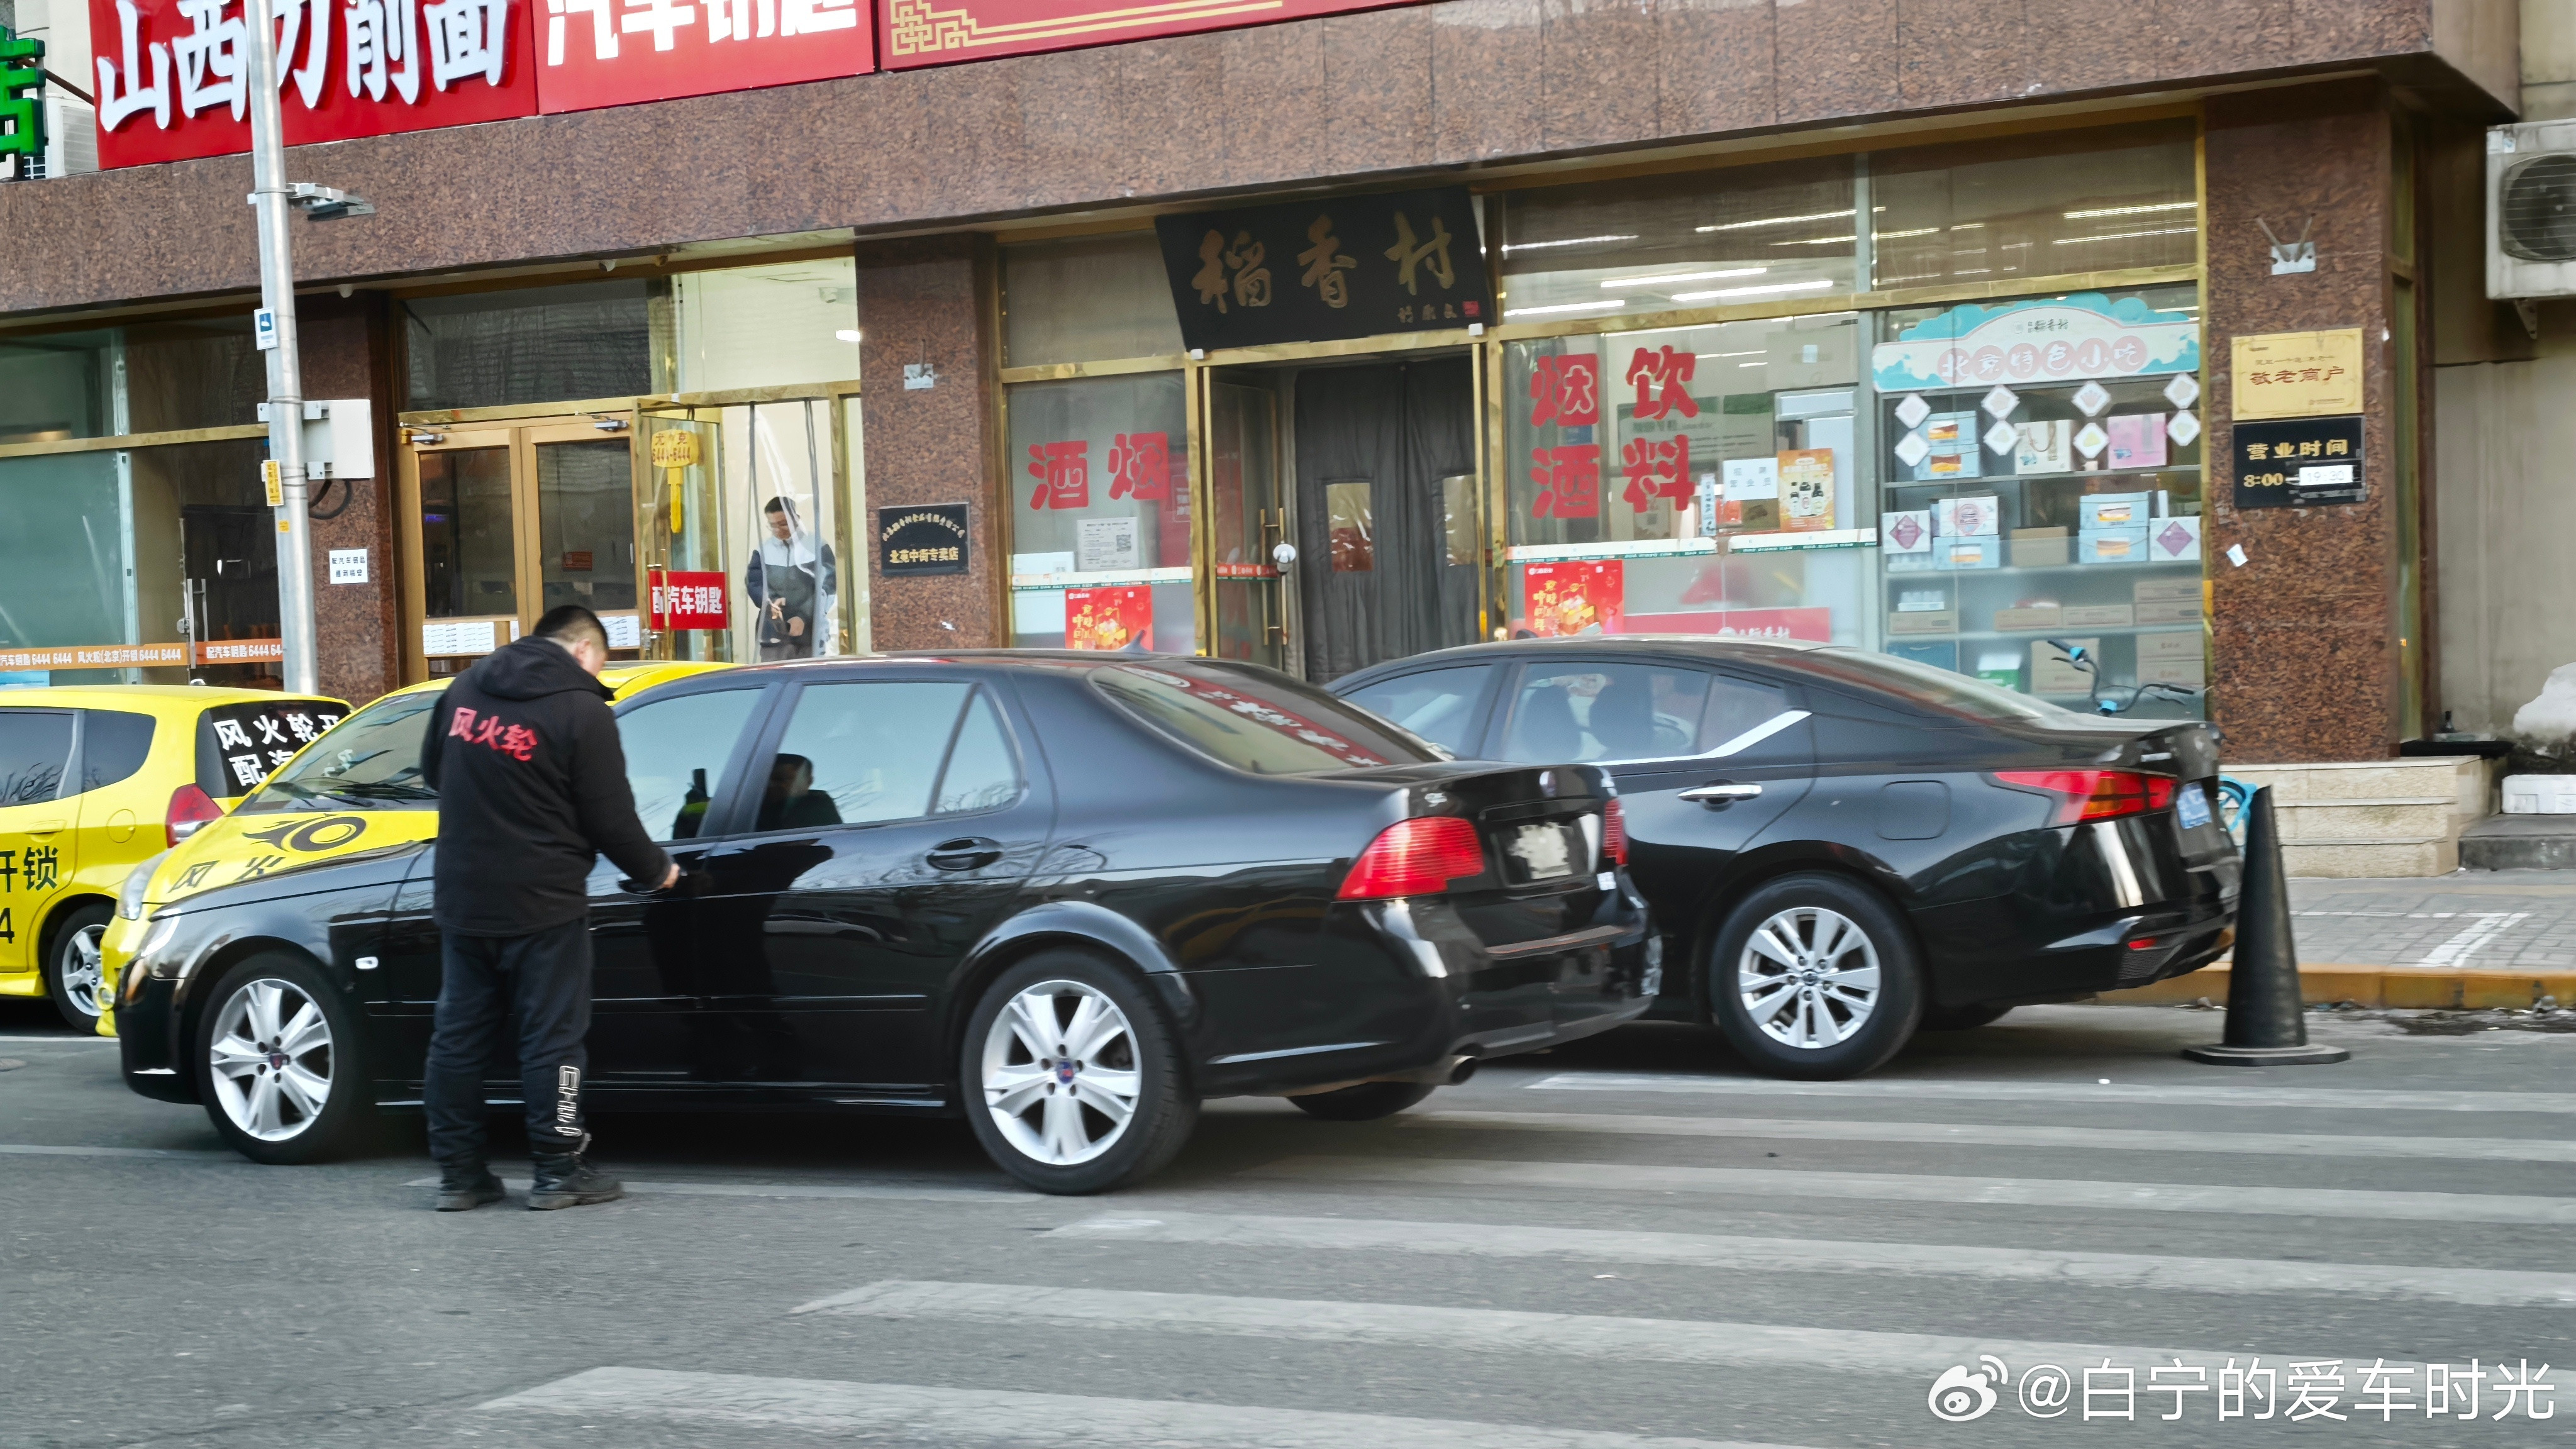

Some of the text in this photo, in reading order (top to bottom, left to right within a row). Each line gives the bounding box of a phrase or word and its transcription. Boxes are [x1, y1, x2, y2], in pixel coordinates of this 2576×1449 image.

[1192, 211, 1455, 314] 稻香村
[1941, 343, 2140, 379] 北京特色小吃
[1622, 345, 1699, 513] 饮料
[2247, 440, 2348, 460] 营业时间
[652, 586, 723, 614] 配汽车钥匙
[448, 707, 538, 761] 风火轮
